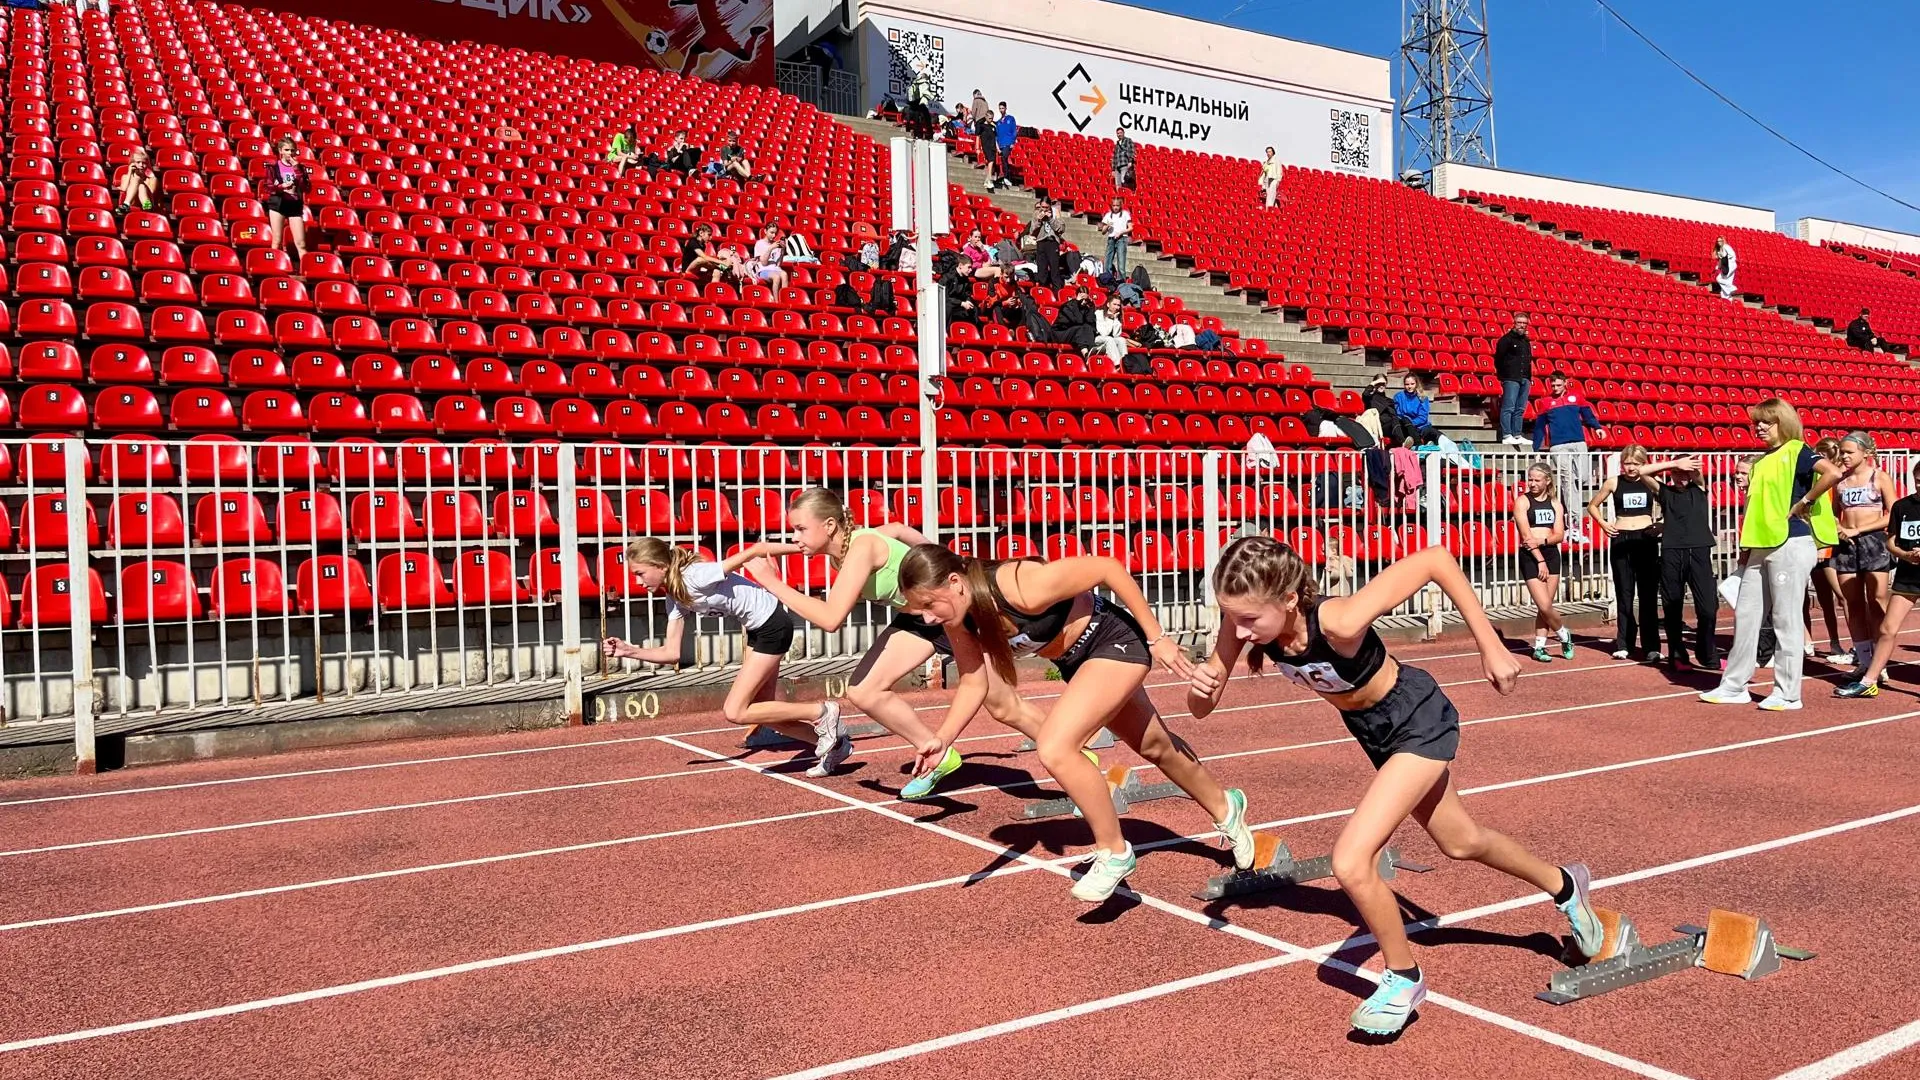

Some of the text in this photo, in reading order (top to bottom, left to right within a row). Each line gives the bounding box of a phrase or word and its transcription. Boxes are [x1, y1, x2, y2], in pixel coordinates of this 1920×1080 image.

[1119, 82, 1249, 122] ЦЕНТРАЛЬНЫЙ
[1119, 112, 1211, 141] СКЛАД.РУ
[48, 349, 55, 357] 8
[52, 444, 58, 452] 8
[132, 444, 138, 452] 9
[1628, 496, 1642, 506] 162
[1846, 491, 1862, 502] 127
[55, 502, 62, 511] 8
[141, 504, 147, 512] 9
[224, 502, 236, 511] 10
[302, 501, 311, 509] 11
[1540, 512, 1552, 521] 112
[476, 555, 484, 563] 13
[325, 567, 335, 576] 11
[154, 573, 161, 582] 9
[58, 581, 65, 591] 8
[826, 676, 849, 698] 10
[624, 690, 660, 719] 60
